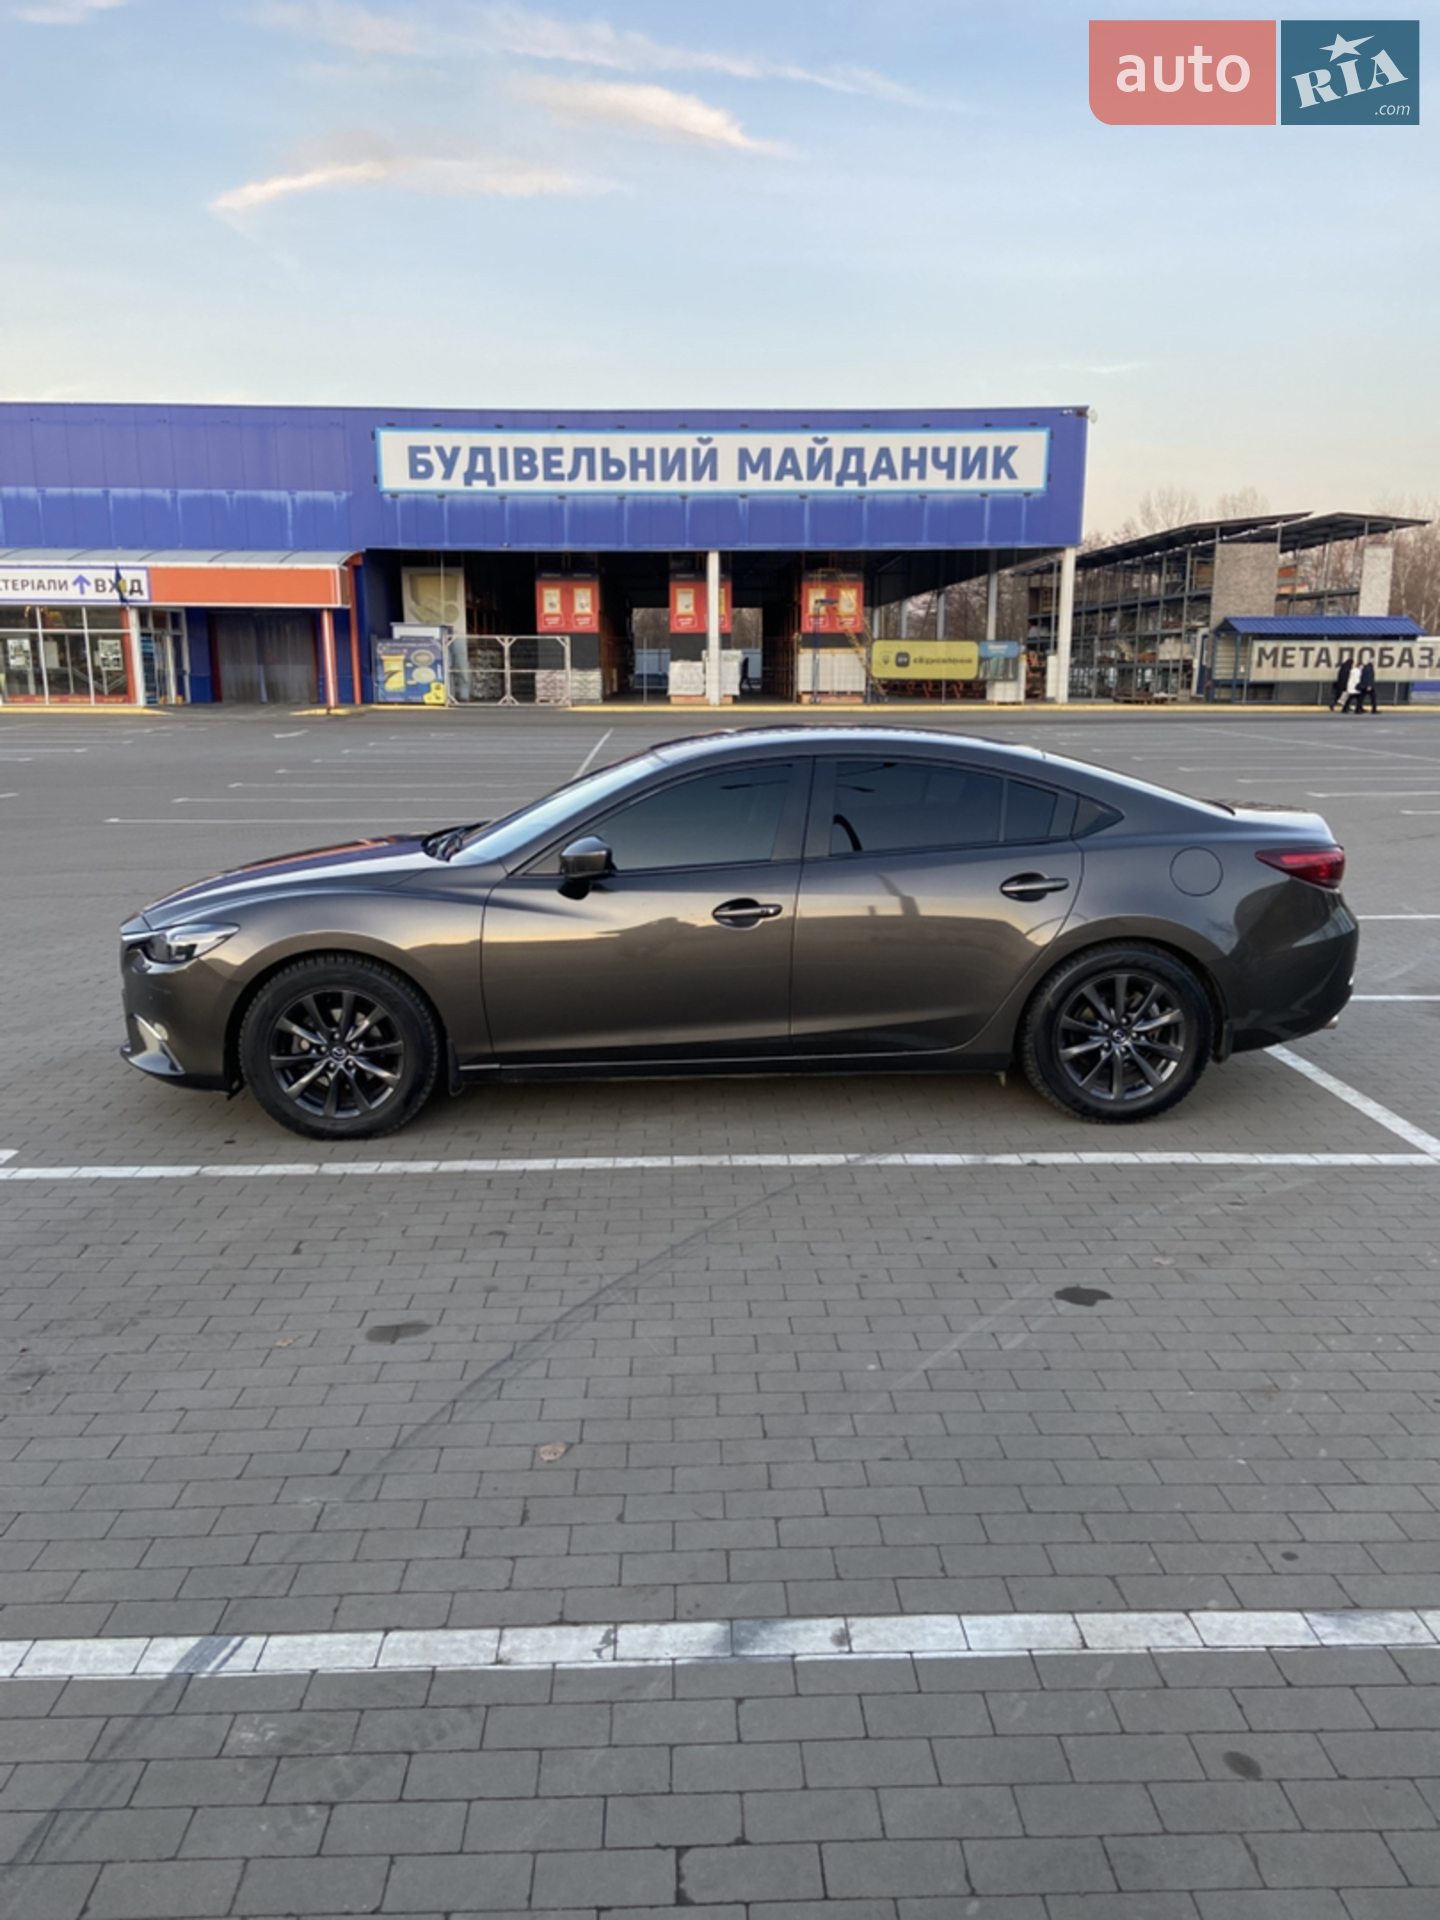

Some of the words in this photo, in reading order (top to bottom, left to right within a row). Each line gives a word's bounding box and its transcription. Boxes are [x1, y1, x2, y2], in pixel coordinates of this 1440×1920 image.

[407, 436, 719, 488] БУДІВЕЛЬНИЙ
[737, 436, 1019, 487] МАЙДАНЧИК
[0, 578, 69, 592] ТЕРІАЛИ
